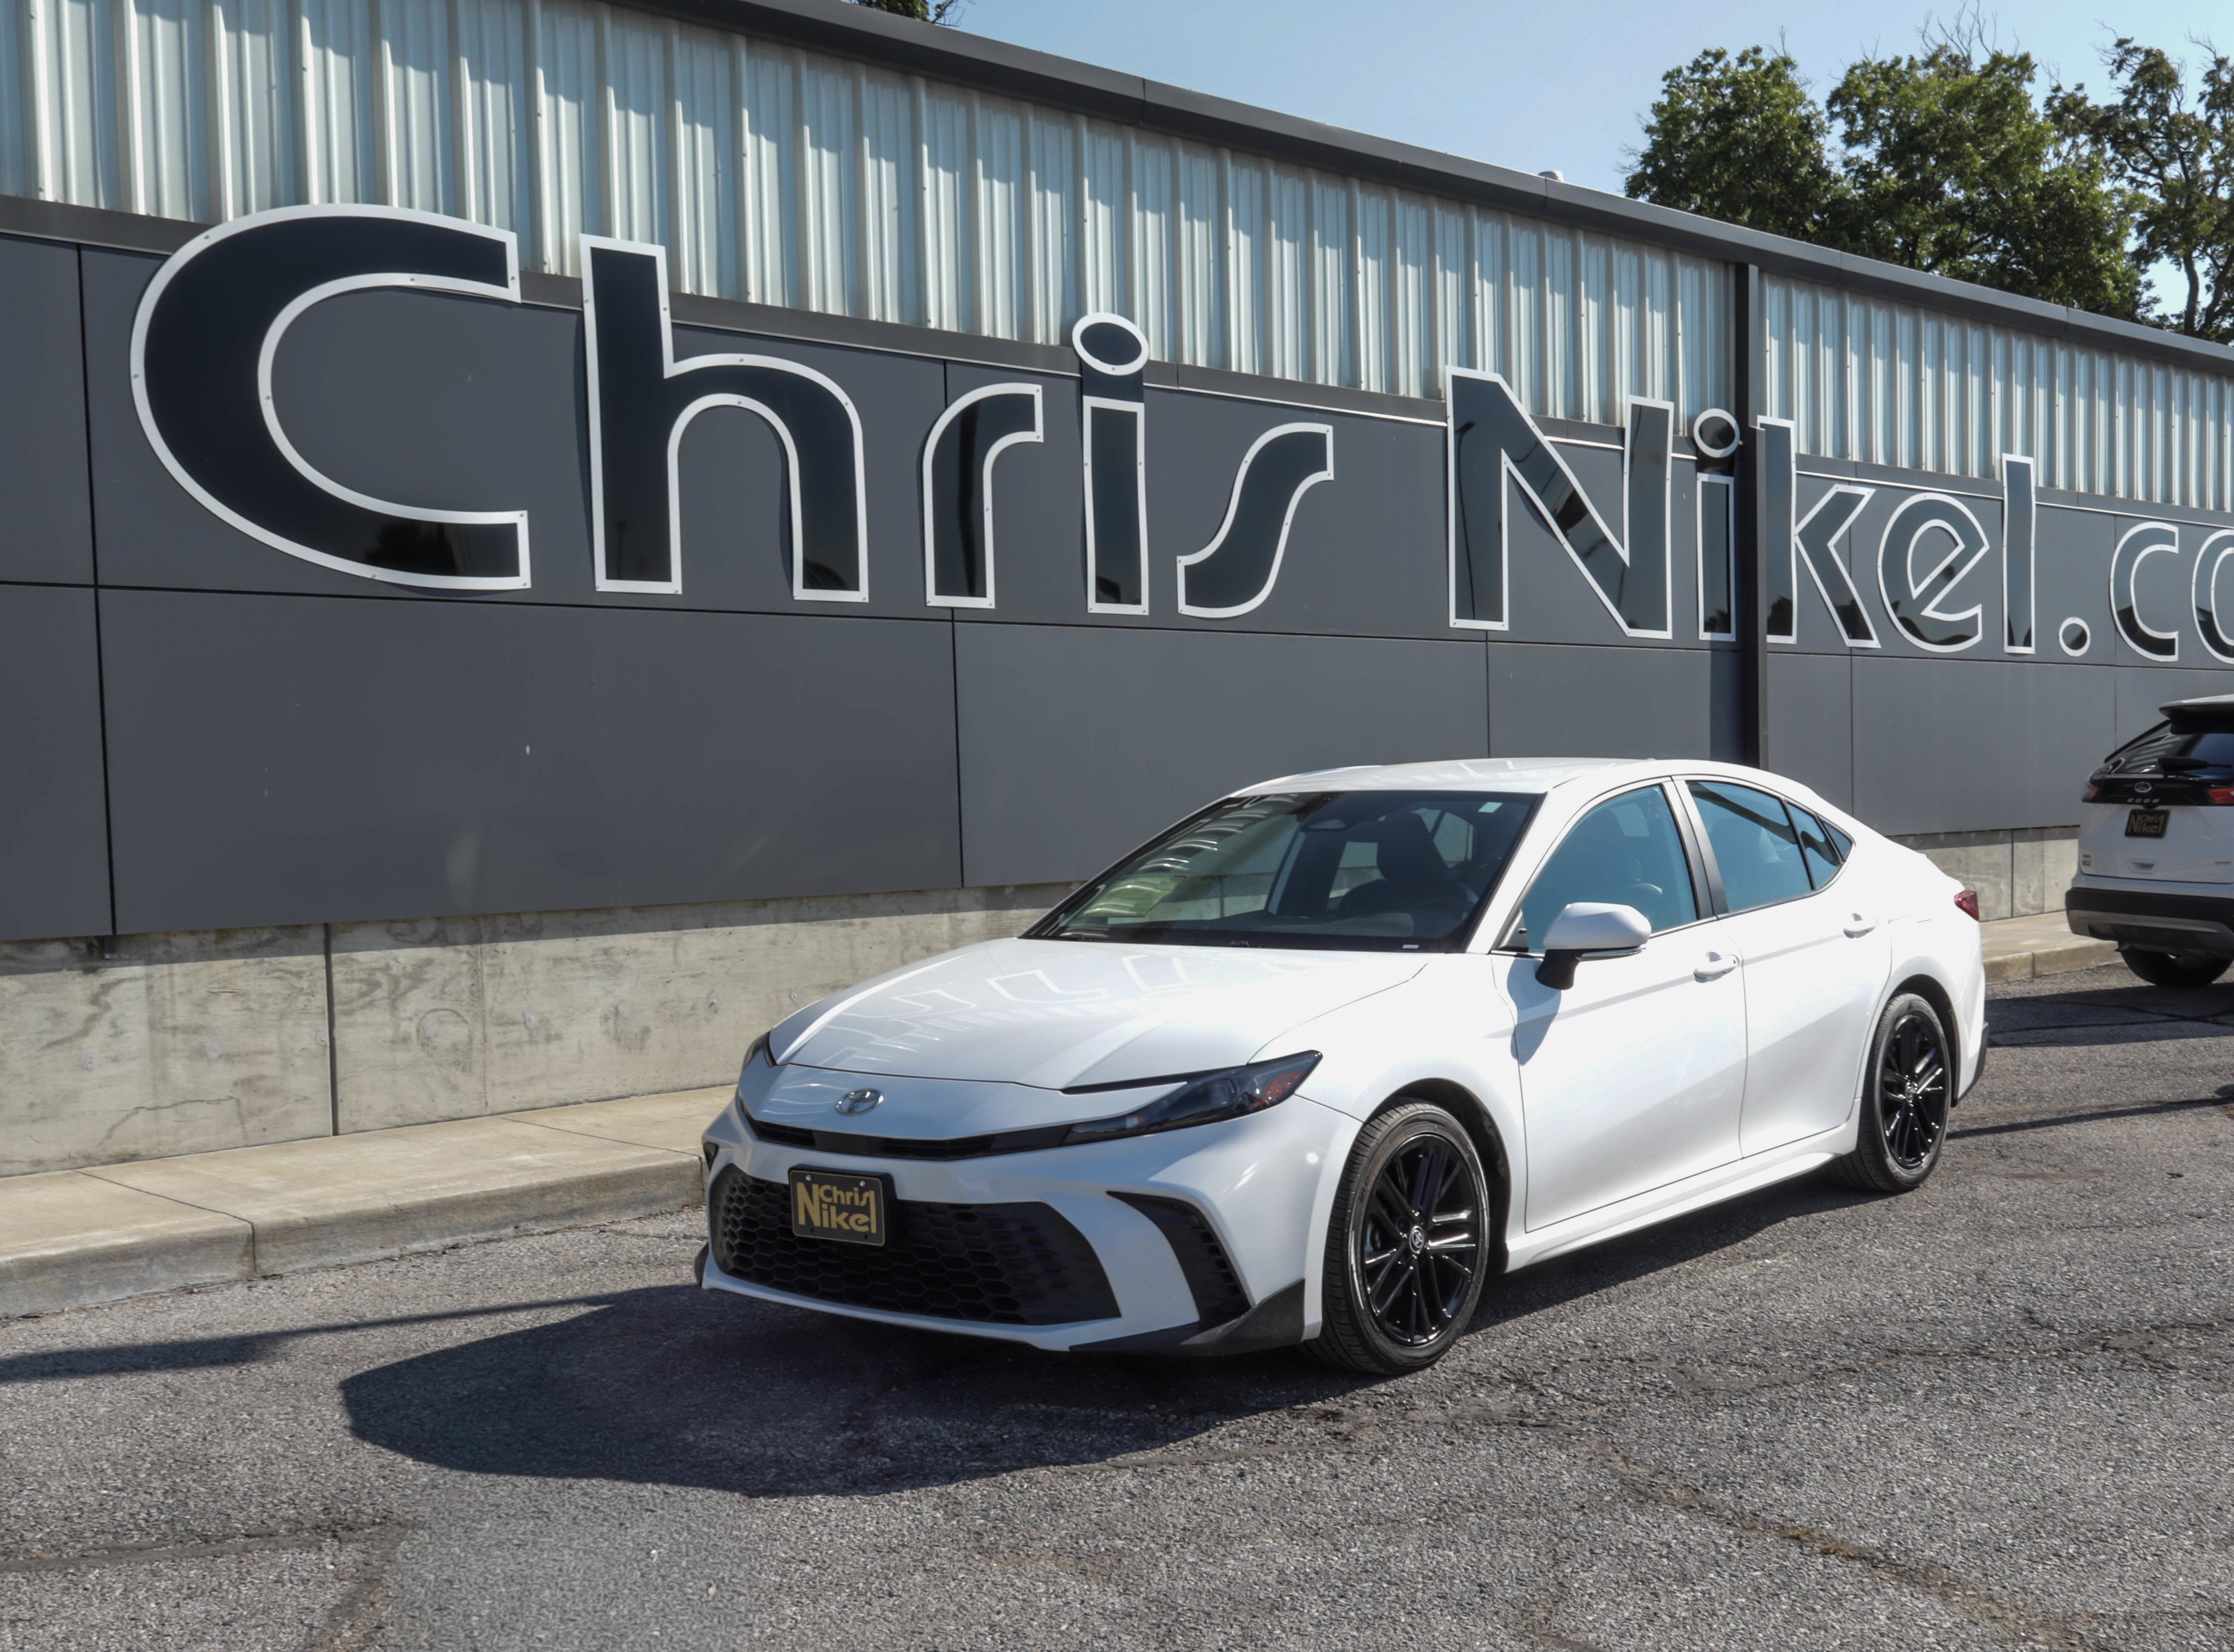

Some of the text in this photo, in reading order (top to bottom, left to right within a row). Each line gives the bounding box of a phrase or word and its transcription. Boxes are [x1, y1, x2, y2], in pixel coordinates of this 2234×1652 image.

[130, 202, 1335, 618] Chris
[2128, 814, 2165, 833] Nikel
[797, 1181, 877, 1234] Nikel
[819, 1184, 873, 1206] Chris
